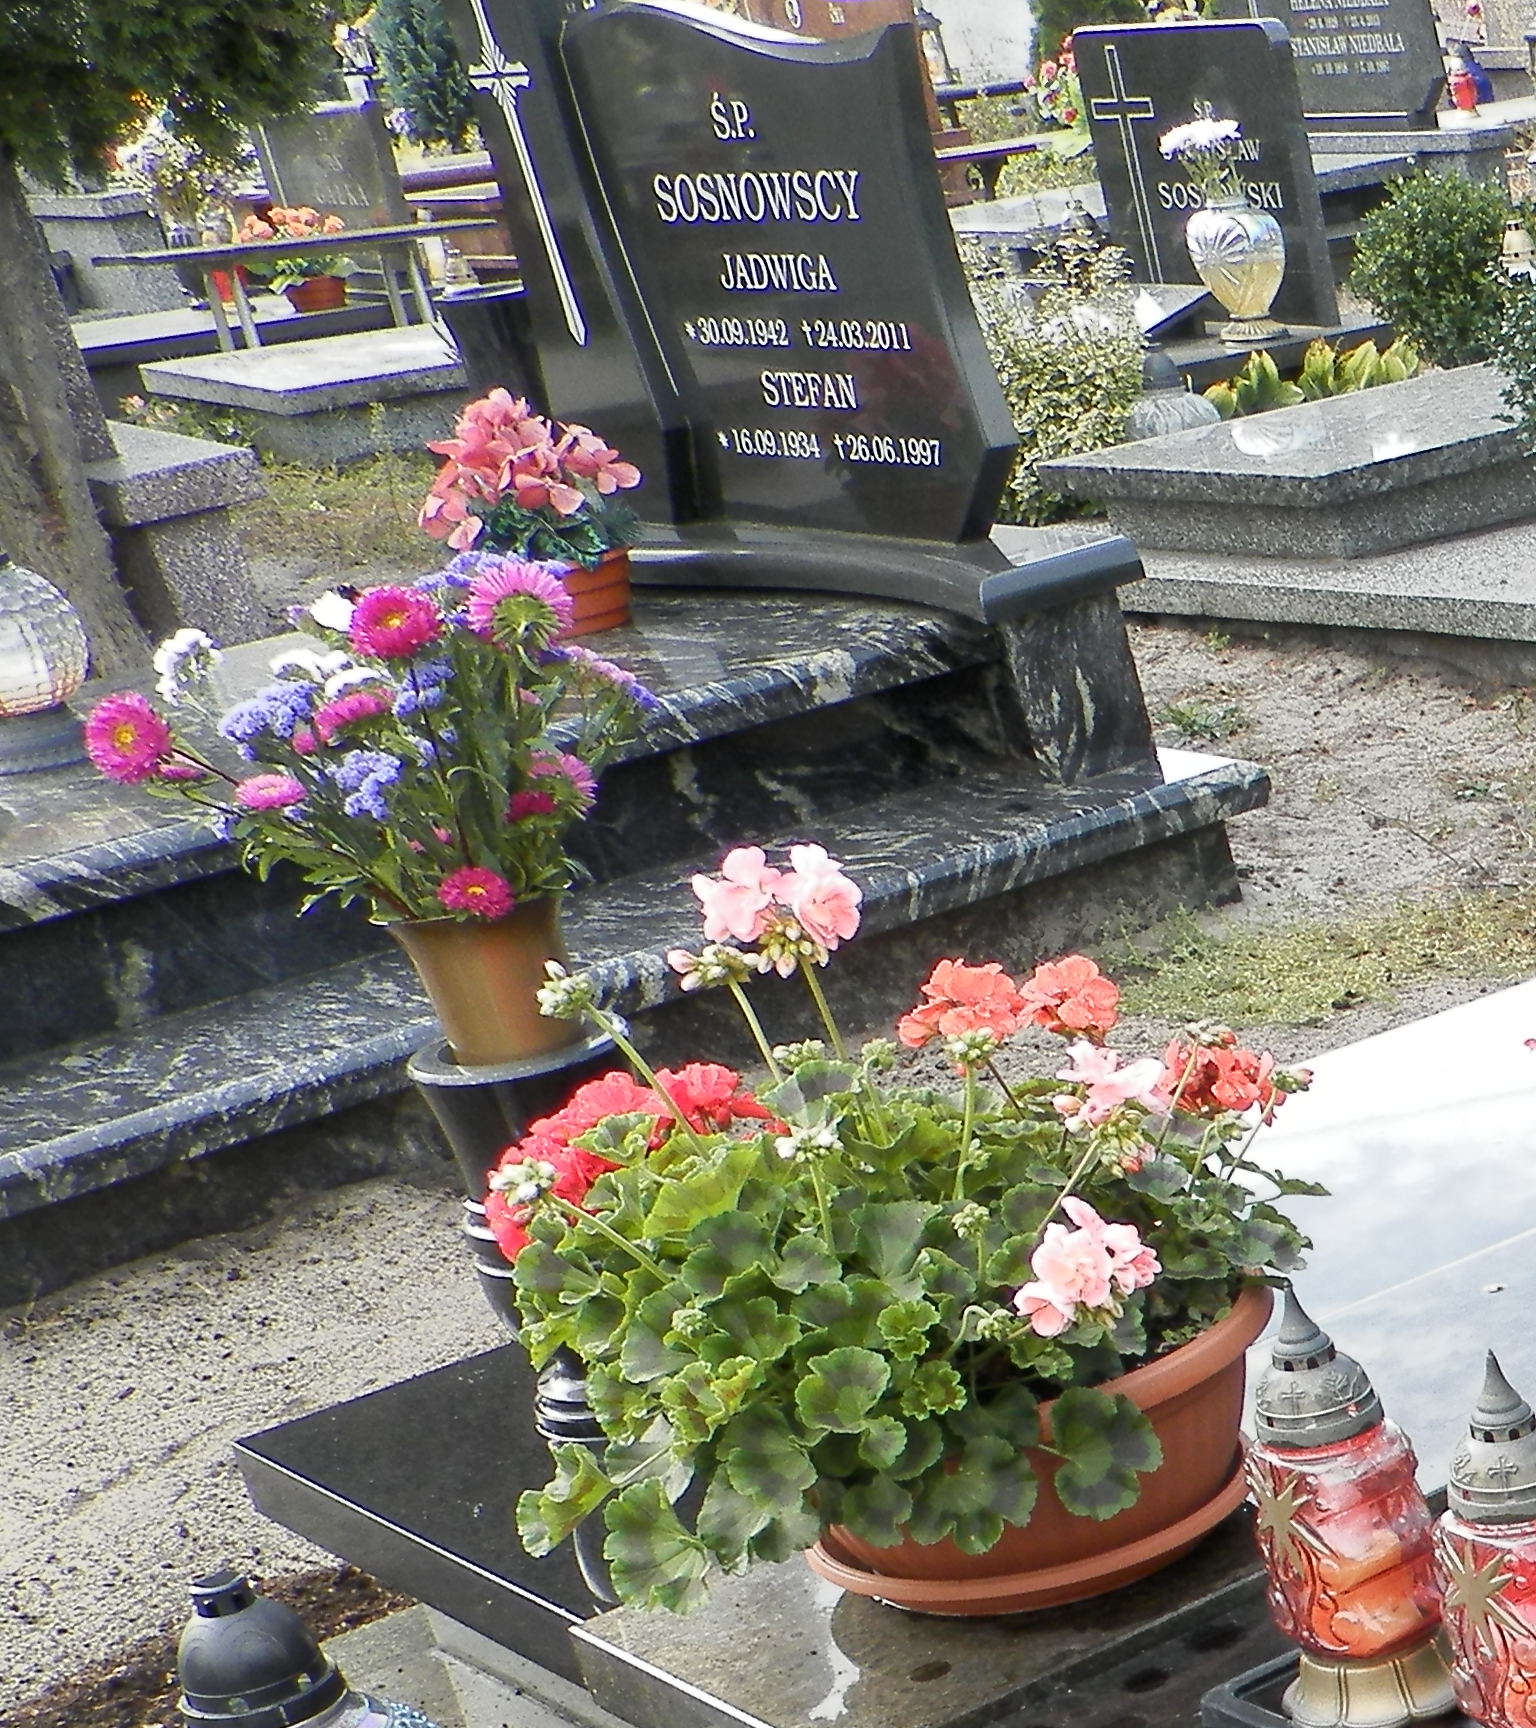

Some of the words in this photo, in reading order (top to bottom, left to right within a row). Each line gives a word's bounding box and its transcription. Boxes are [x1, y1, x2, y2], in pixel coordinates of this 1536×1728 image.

[710, 91, 755, 139] Ś.P.
[653, 169, 861, 223] SOSNOWSCY
[1157, 181, 1285, 210] SOSSKI
[719, 252, 839, 292] JADWIGA
[696, 316, 790, 347] 30.09.1942
[814, 319, 913, 351] 24.03.2011
[759, 370, 858, 410] STEFAN
[731, 428, 822, 459] 16.09.1934
[848, 434, 942, 467] 26.06.1997
